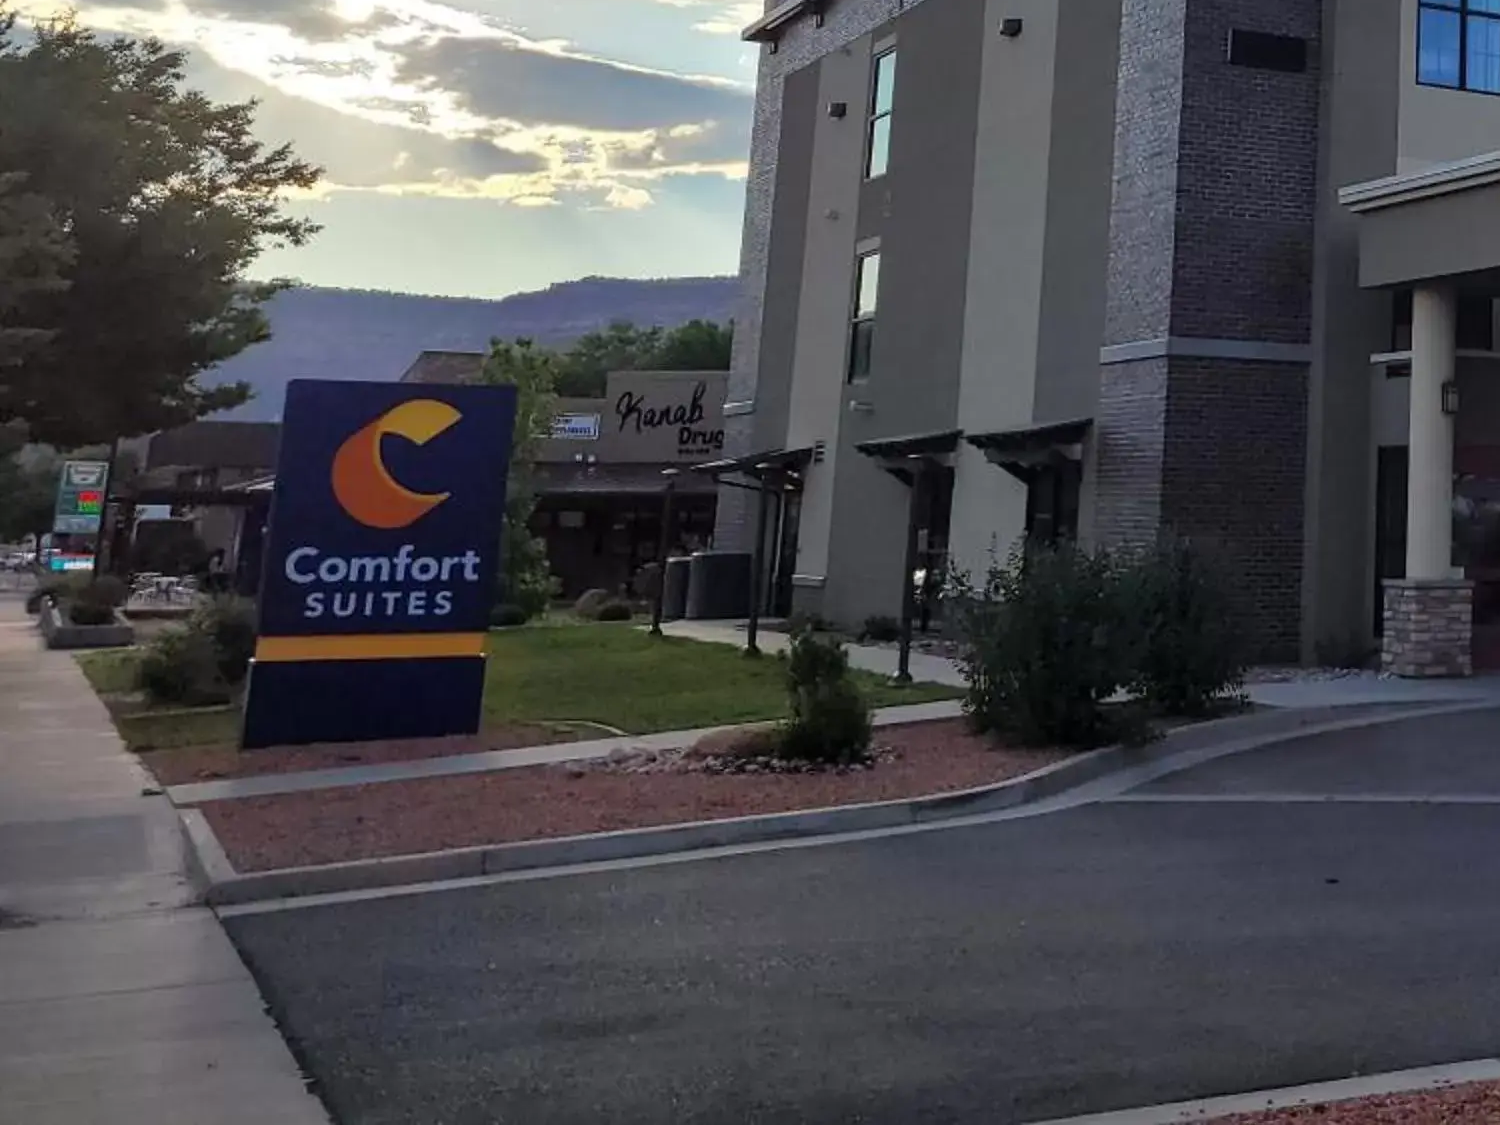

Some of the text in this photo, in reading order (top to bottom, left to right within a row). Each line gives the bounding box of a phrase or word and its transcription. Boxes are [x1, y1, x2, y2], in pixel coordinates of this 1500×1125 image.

[616, 380, 706, 433] Kanab
[678, 426, 724, 449] Drug
[285, 544, 480, 583] Comfort
[303, 590, 453, 618] SUITES
